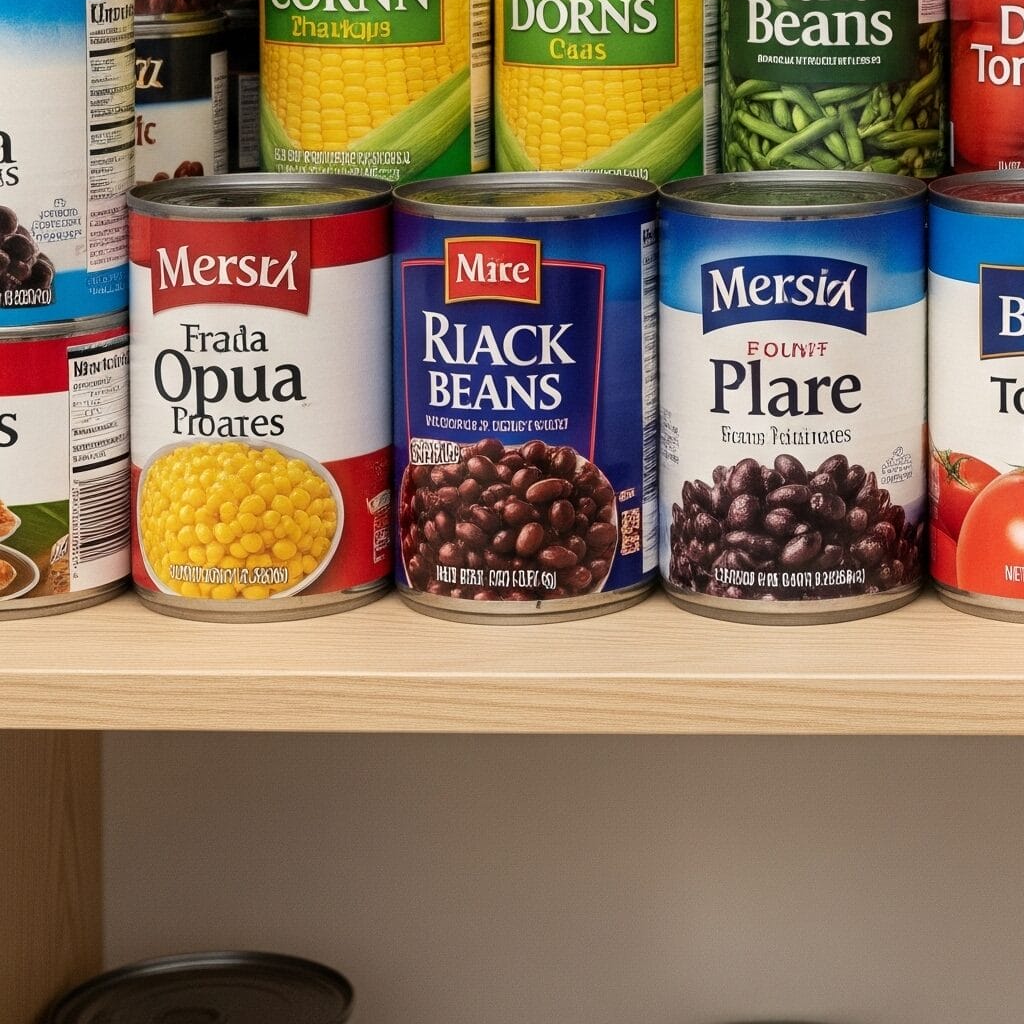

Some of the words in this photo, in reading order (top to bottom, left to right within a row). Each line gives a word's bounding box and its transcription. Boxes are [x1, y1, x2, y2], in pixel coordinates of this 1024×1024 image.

[154, 348, 306, 419] Opua
[428, 371, 562, 411] BEANS
[710, 358, 862, 418] Plare
